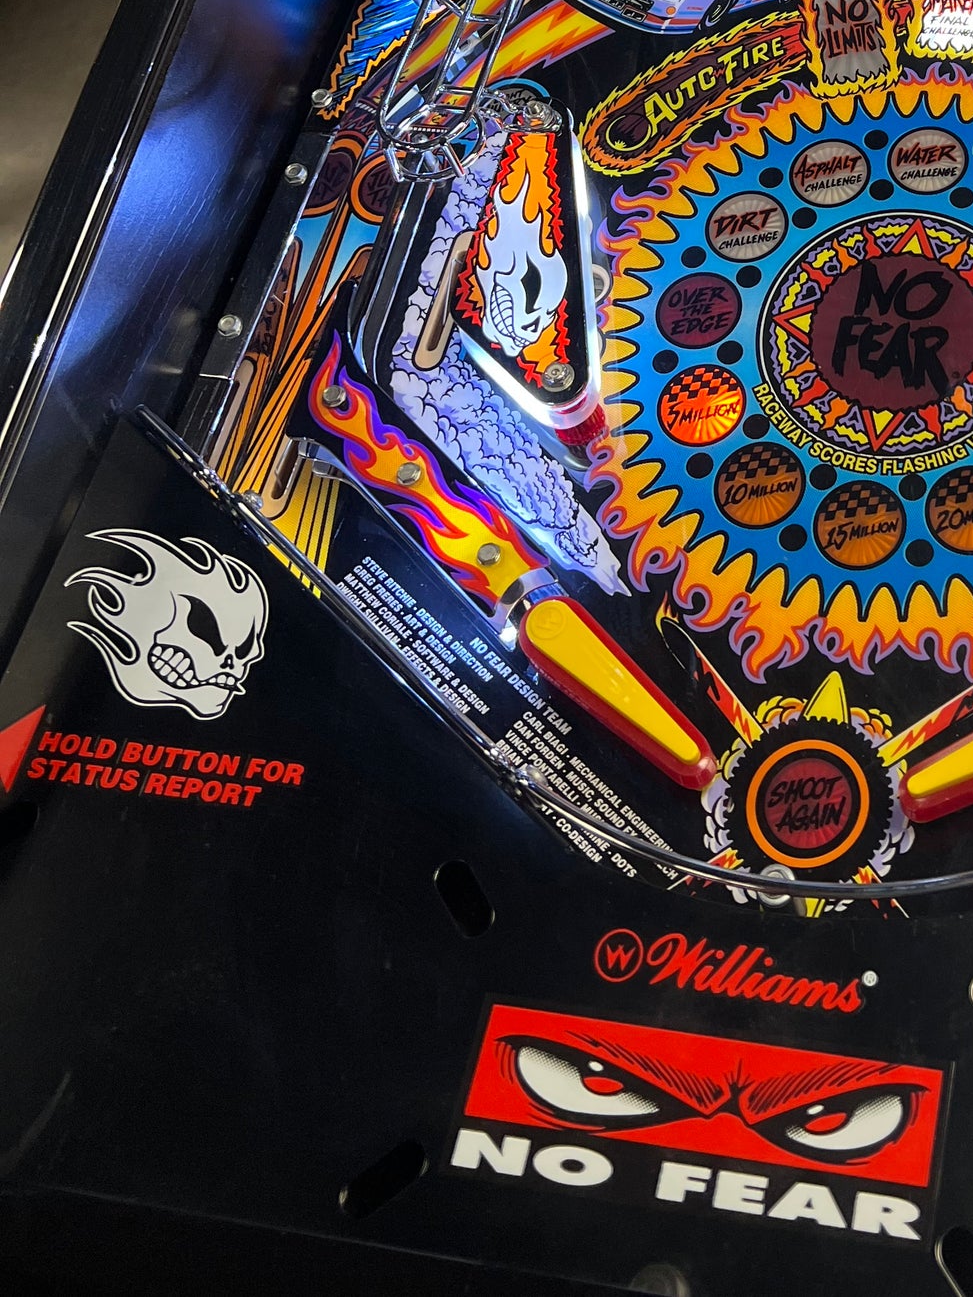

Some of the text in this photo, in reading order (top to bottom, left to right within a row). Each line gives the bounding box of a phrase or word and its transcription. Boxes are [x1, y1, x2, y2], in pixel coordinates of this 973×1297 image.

[930, 15, 971, 27] FINAL
[824, 21, 877, 59] LIMITS
[794, 154, 862, 186] ASPHALT
[896, 142, 957, 167] WATER
[804, 174, 863, 193] CHALLENGE
[900, 167, 958, 181] CHALLENGE
[713, 207, 778, 239] DIRT
[718, 231, 780, 250] CHALLENGE
[667, 285, 728, 308] OVER
[853, 260, 952, 321] NO
[670, 312, 731, 336] EDGE
[679, 304, 712, 317] THE
[832, 315, 951, 400] FEAR
[667, 399, 741, 431] 5 MILLION
[753, 383, 814, 449] RACEWAY
[810, 441, 878, 475] SCORES
[882, 446, 968, 476] FLASHING
[721, 478, 798, 507] 10 MILLION
[824, 517, 899, 552] 15 MILLION
[936, 505, 965, 532] 20
[353, 565, 376, 587] GREG
[373, 584, 404, 613] FRERES
[402, 615, 420, 631] ART
[425, 634, 457, 665] DESIGN
[362, 556, 389, 582] STEVE
[386, 579, 417, 609] RITCHIE
[416, 608, 448, 638] DESIGN
[451, 641, 494, 683] DIRECTION
[336, 582, 368, 612] DWIGHT
[364, 608, 401, 644] SULLIVAN
[400, 646, 435, 679] EFFECTS
[439, 685, 471, 714] DESIGN
[344, 573, 382, 609] MATTHEW
[378, 607, 412, 639] CORIALE
[412, 640, 455, 681] SOFTWARE
[458, 685, 490, 715] DESIGN
[469, 637, 573, 736] NO FEAR DESIGN TEAM
[38, 731, 305, 786] HOLD BUTTON FOR
[495, 740, 524, 767] BRIAN
[505, 729, 578, 806] VINCE PONTARELLI
[27, 757, 262, 808] STATUS REPORT
[513, 720, 532, 741] DAN
[530, 738, 565, 770] FORDEN
[565, 769, 595, 802] MUSIC,
[594, 798, 625, 828] SOUND
[522, 711, 544, 730] CARL
[543, 730, 568, 756] BIAGI
[569, 755, 622, 809] MECHANICAL
[620, 805, 674, 853] ENGINEERIN
[771, 775, 843, 807] SHOOT
[776, 799, 845, 833] AGAIN
[556, 818, 603, 863] CO-DESIGN
[611, 852, 638, 878] DOTS
[646, 932, 862, 1013] Williams
[450, 1128, 921, 1241] NO FEAR
